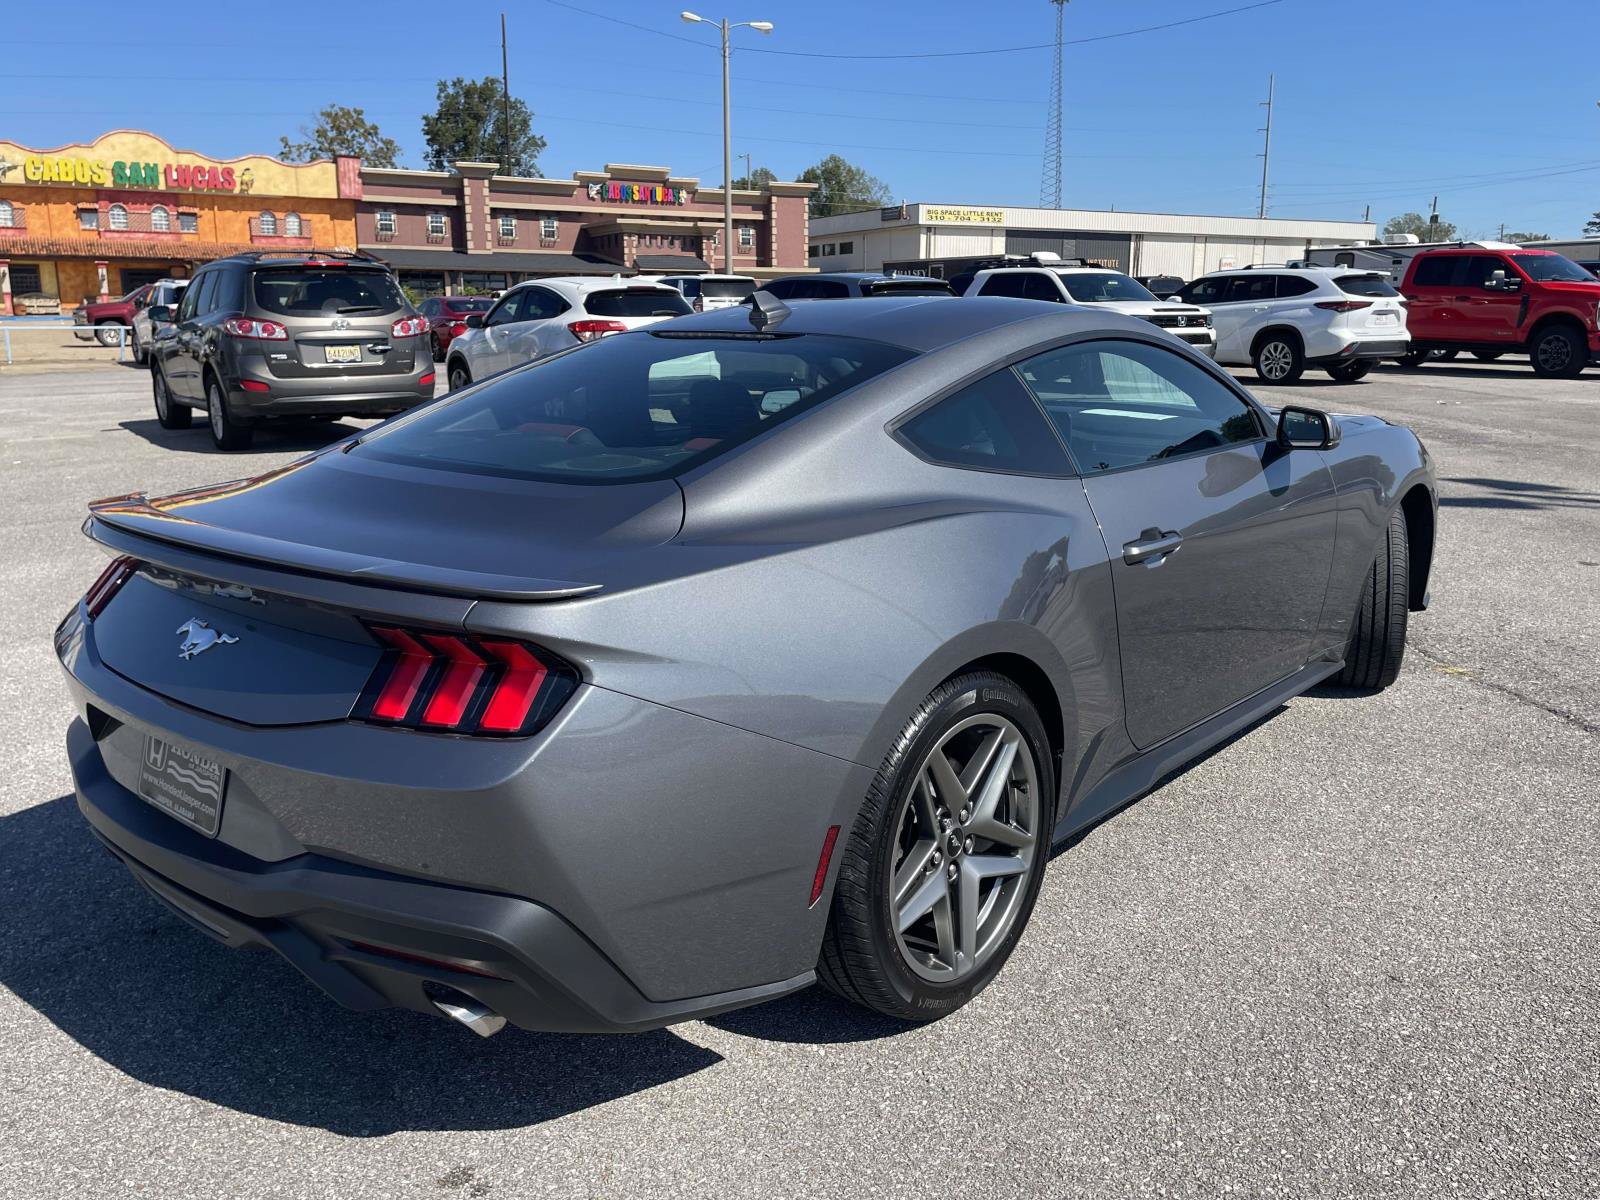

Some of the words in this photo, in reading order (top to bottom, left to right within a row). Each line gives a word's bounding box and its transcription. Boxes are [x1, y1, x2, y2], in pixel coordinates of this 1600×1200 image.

[25, 156, 105, 184] CABOS
[112, 160, 159, 187] SAN
[164, 163, 236, 190] LUCAS
[602, 182, 632, 201] CABOS
[632, 183, 650, 201] SAN
[651, 185, 679, 203] LUCAS
